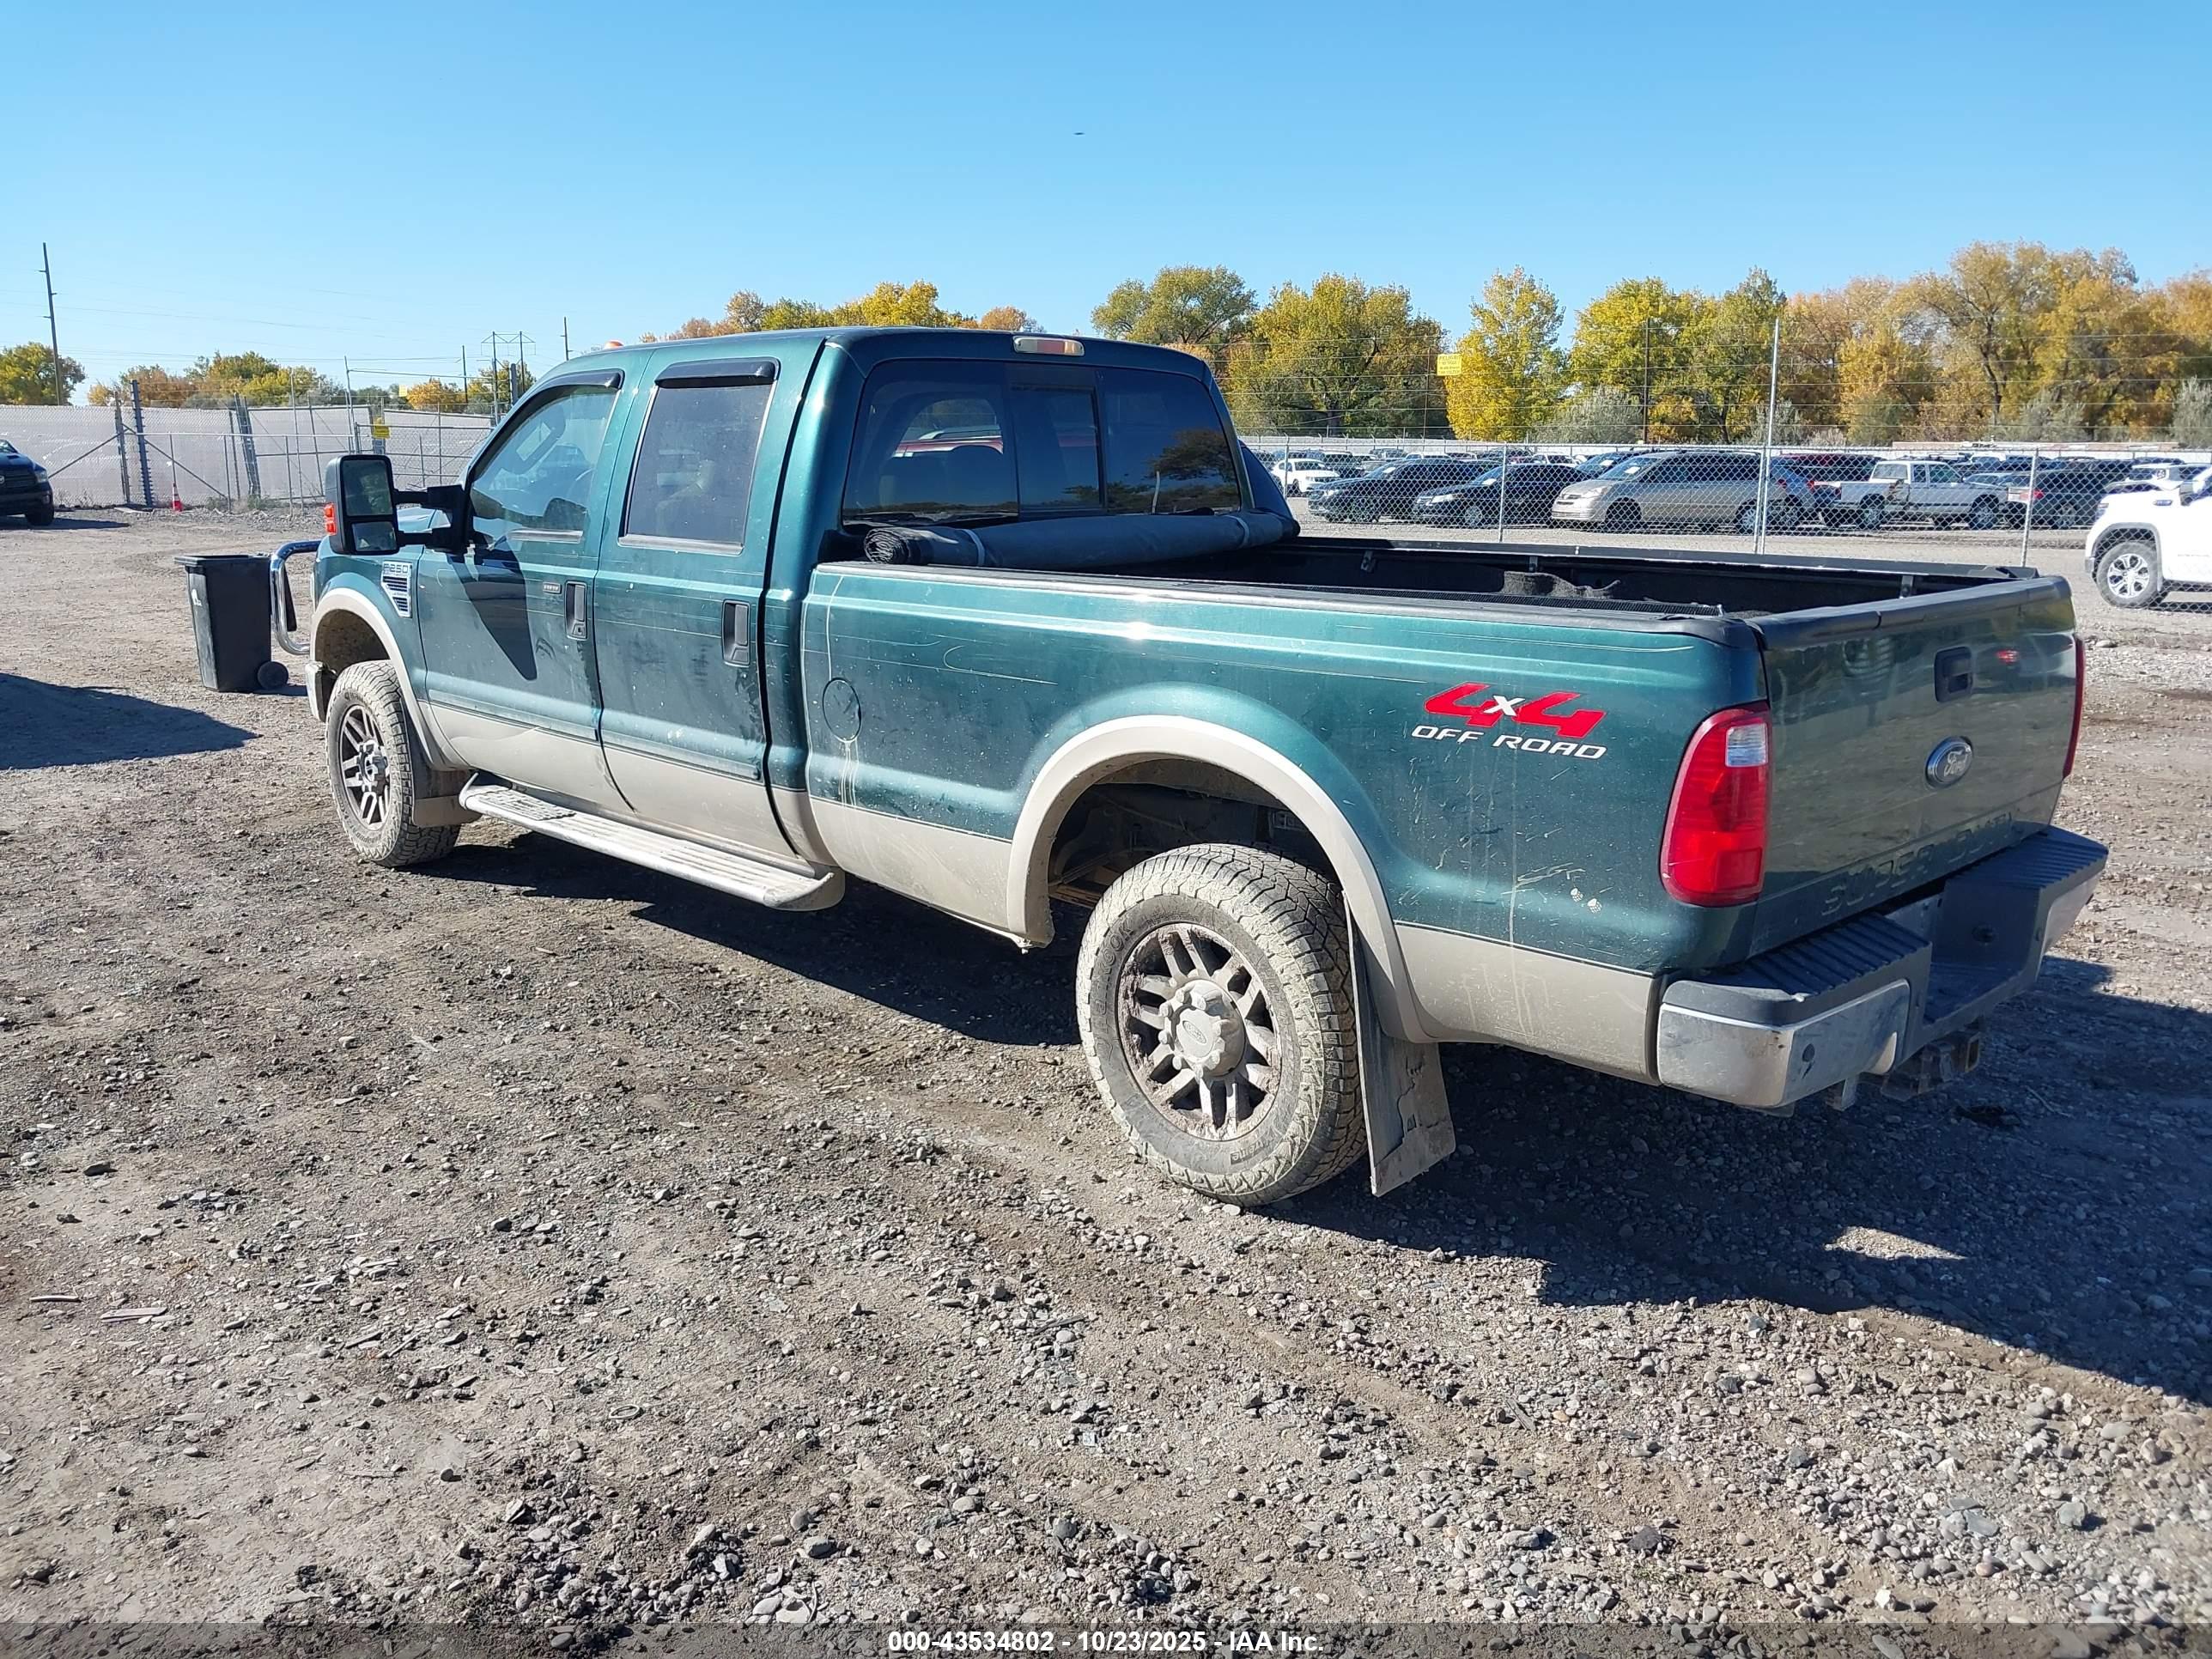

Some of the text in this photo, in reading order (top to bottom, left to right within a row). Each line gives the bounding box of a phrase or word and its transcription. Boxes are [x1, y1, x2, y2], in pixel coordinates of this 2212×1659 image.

[1423, 681, 1607, 739] 4x4
[1411, 725, 1608, 760] OFF ROAD
